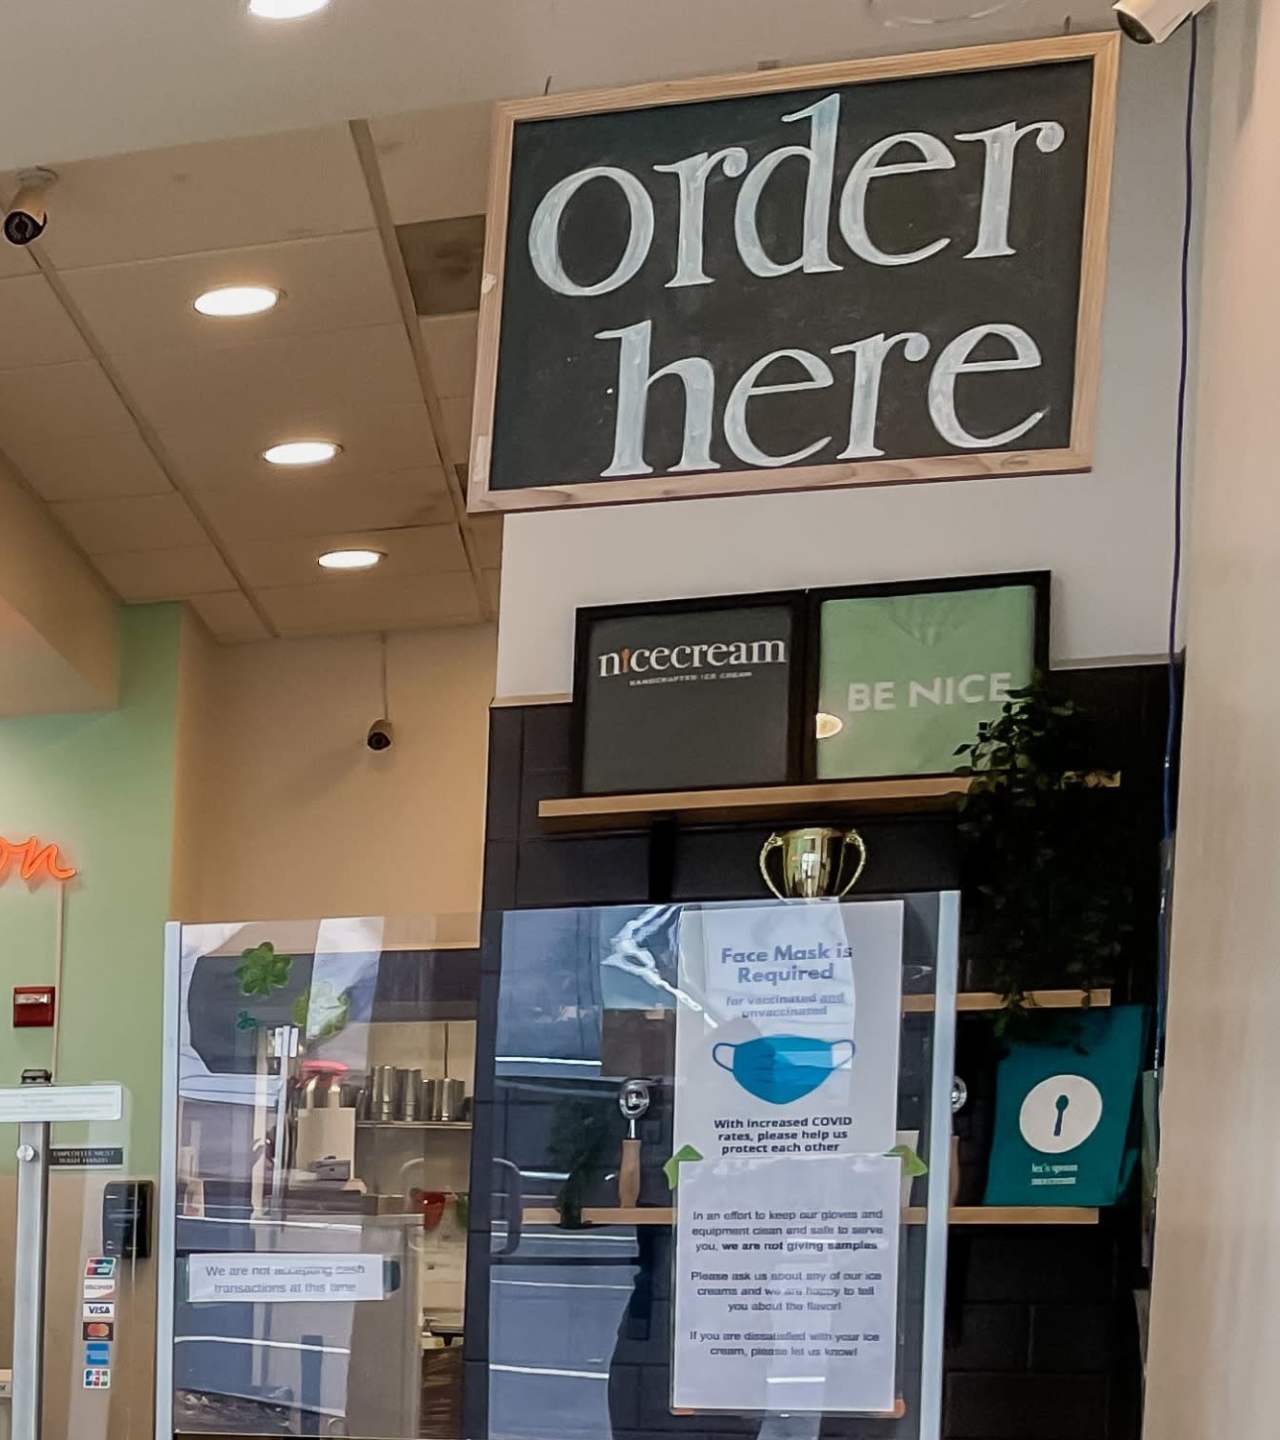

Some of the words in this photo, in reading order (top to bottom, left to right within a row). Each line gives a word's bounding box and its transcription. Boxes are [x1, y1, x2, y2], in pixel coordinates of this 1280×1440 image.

[527, 93, 1065, 297] order
[595, 320, 1051, 477] here
[599, 640, 786, 677] nicecream
[848, 682, 896, 712] BE
[909, 672, 1012, 708] NICE
[722, 946, 767, 963] Face
[774, 943, 830, 961] Mask
[836, 943, 852, 958] is
[738, 964, 833, 984] Required
[726, 995, 744, 1006] for
[748, 994, 817, 1005] vaccinated
[819, 993, 844, 1004] and
[742, 1007, 827, 1018] unvaccinated
[714, 1119, 744, 1129] With
[747, 1118, 808, 1127] increased
[812, 1117, 852, 1126] COVID
[719, 1132, 753, 1141] rates,
[758, 1131, 798, 1142] please
[802, 1130, 829, 1140] help
[722, 1145, 767, 1155] protect
[771, 1143, 801, 1152] each
[805, 1143, 839, 1152] other
[693, 1211, 703, 1220] In
[707, 1212, 720, 1220] an
[724, 1210, 752, 1220] effort
[755, 1211, 766, 1220] to
[769, 1210, 796, 1222] keep
[800, 1212, 817, 1220] our
[821, 1211, 858, 1221] gloves
[861, 1210, 883, 1219] and
[692, 1227, 749, 1237] equipment
[753, 1226, 782, 1235] clean
[786, 1226, 807, 1235] and
[810, 1226, 834, 1235] safe
[838, 1226, 848, 1235] to
[852, 1227, 883, 1235] serve
[764, 1242, 783, 1250] not
[787, 1241, 823, 1252] giving
[206, 1266, 225, 1276] We
[229, 1267, 248, 1276] are
[252, 1266, 270, 1275] not
[691, 1272, 728, 1280] Please
[732, 1272, 750, 1280] ask
[771, 1272, 802, 1280] about
[806, 1273, 826, 1282] any
[830, 1272, 841, 1280] of
[865, 1272, 882, 1280] ice
[215, 1283, 286, 1293] transactions
[290, 1284, 301, 1292] at
[305, 1283, 325, 1292] this
[330, 1283, 356, 1292] time
[741, 1287, 761, 1295] and
[806, 1287, 839, 1297] happy
[843, 1287, 854, 1295] to
[858, 1286, 874, 1295] tell
[88, 1306, 110, 1314] VISA
[728, 1303, 748, 1312] you
[752, 1302, 783, 1311] about
[786, 1302, 803, 1311] the
[690, 1332, 699, 1340] If
[700, 1333, 720, 1342] you
[744, 1332, 805, 1341] dissatisfied
[835, 1334, 859, 1342] your
[863, 1333, 879, 1341] ice
[751, 1347, 787, 1357] please
[791, 1347, 804, 1355] let
